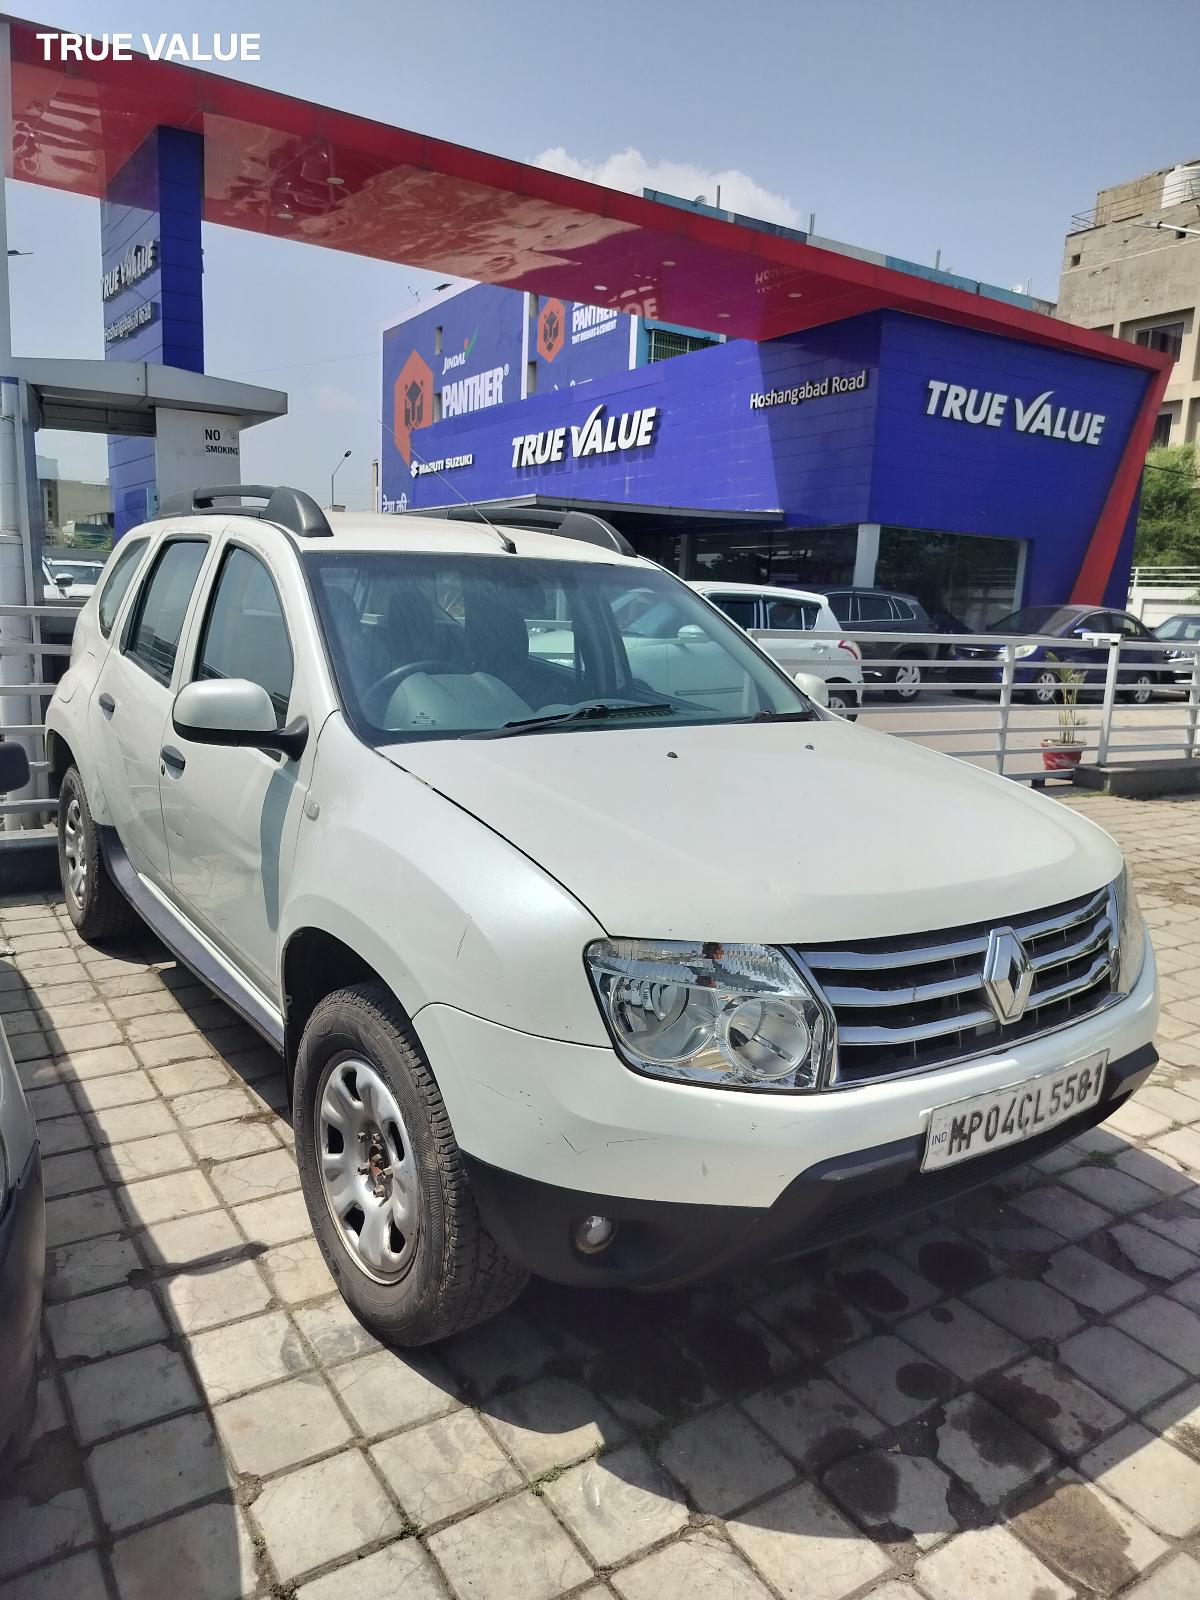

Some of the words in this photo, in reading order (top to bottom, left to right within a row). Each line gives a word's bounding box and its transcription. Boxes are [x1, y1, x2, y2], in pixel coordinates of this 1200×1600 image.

[101, 264, 120, 300] TRUE
[120, 240, 154, 286] VALUE
[442, 351, 466, 375] JINDAL
[750, 378, 829, 409] Hoshangabad
[831, 369, 866, 393] Road
[926, 379, 1009, 428] TRUE
[1014, 390, 1106, 446] VALUE
[204, 429, 221, 441] NO
[511, 427, 566, 468] TRUE
[570, 404, 657, 458] VALUE
[419, 460, 444, 475] MARUTI
[445, 453, 473, 469] SUZUKI
[948, 1061, 1104, 1156] MP04CL5581
[931, 1130, 948, 1146] IND
